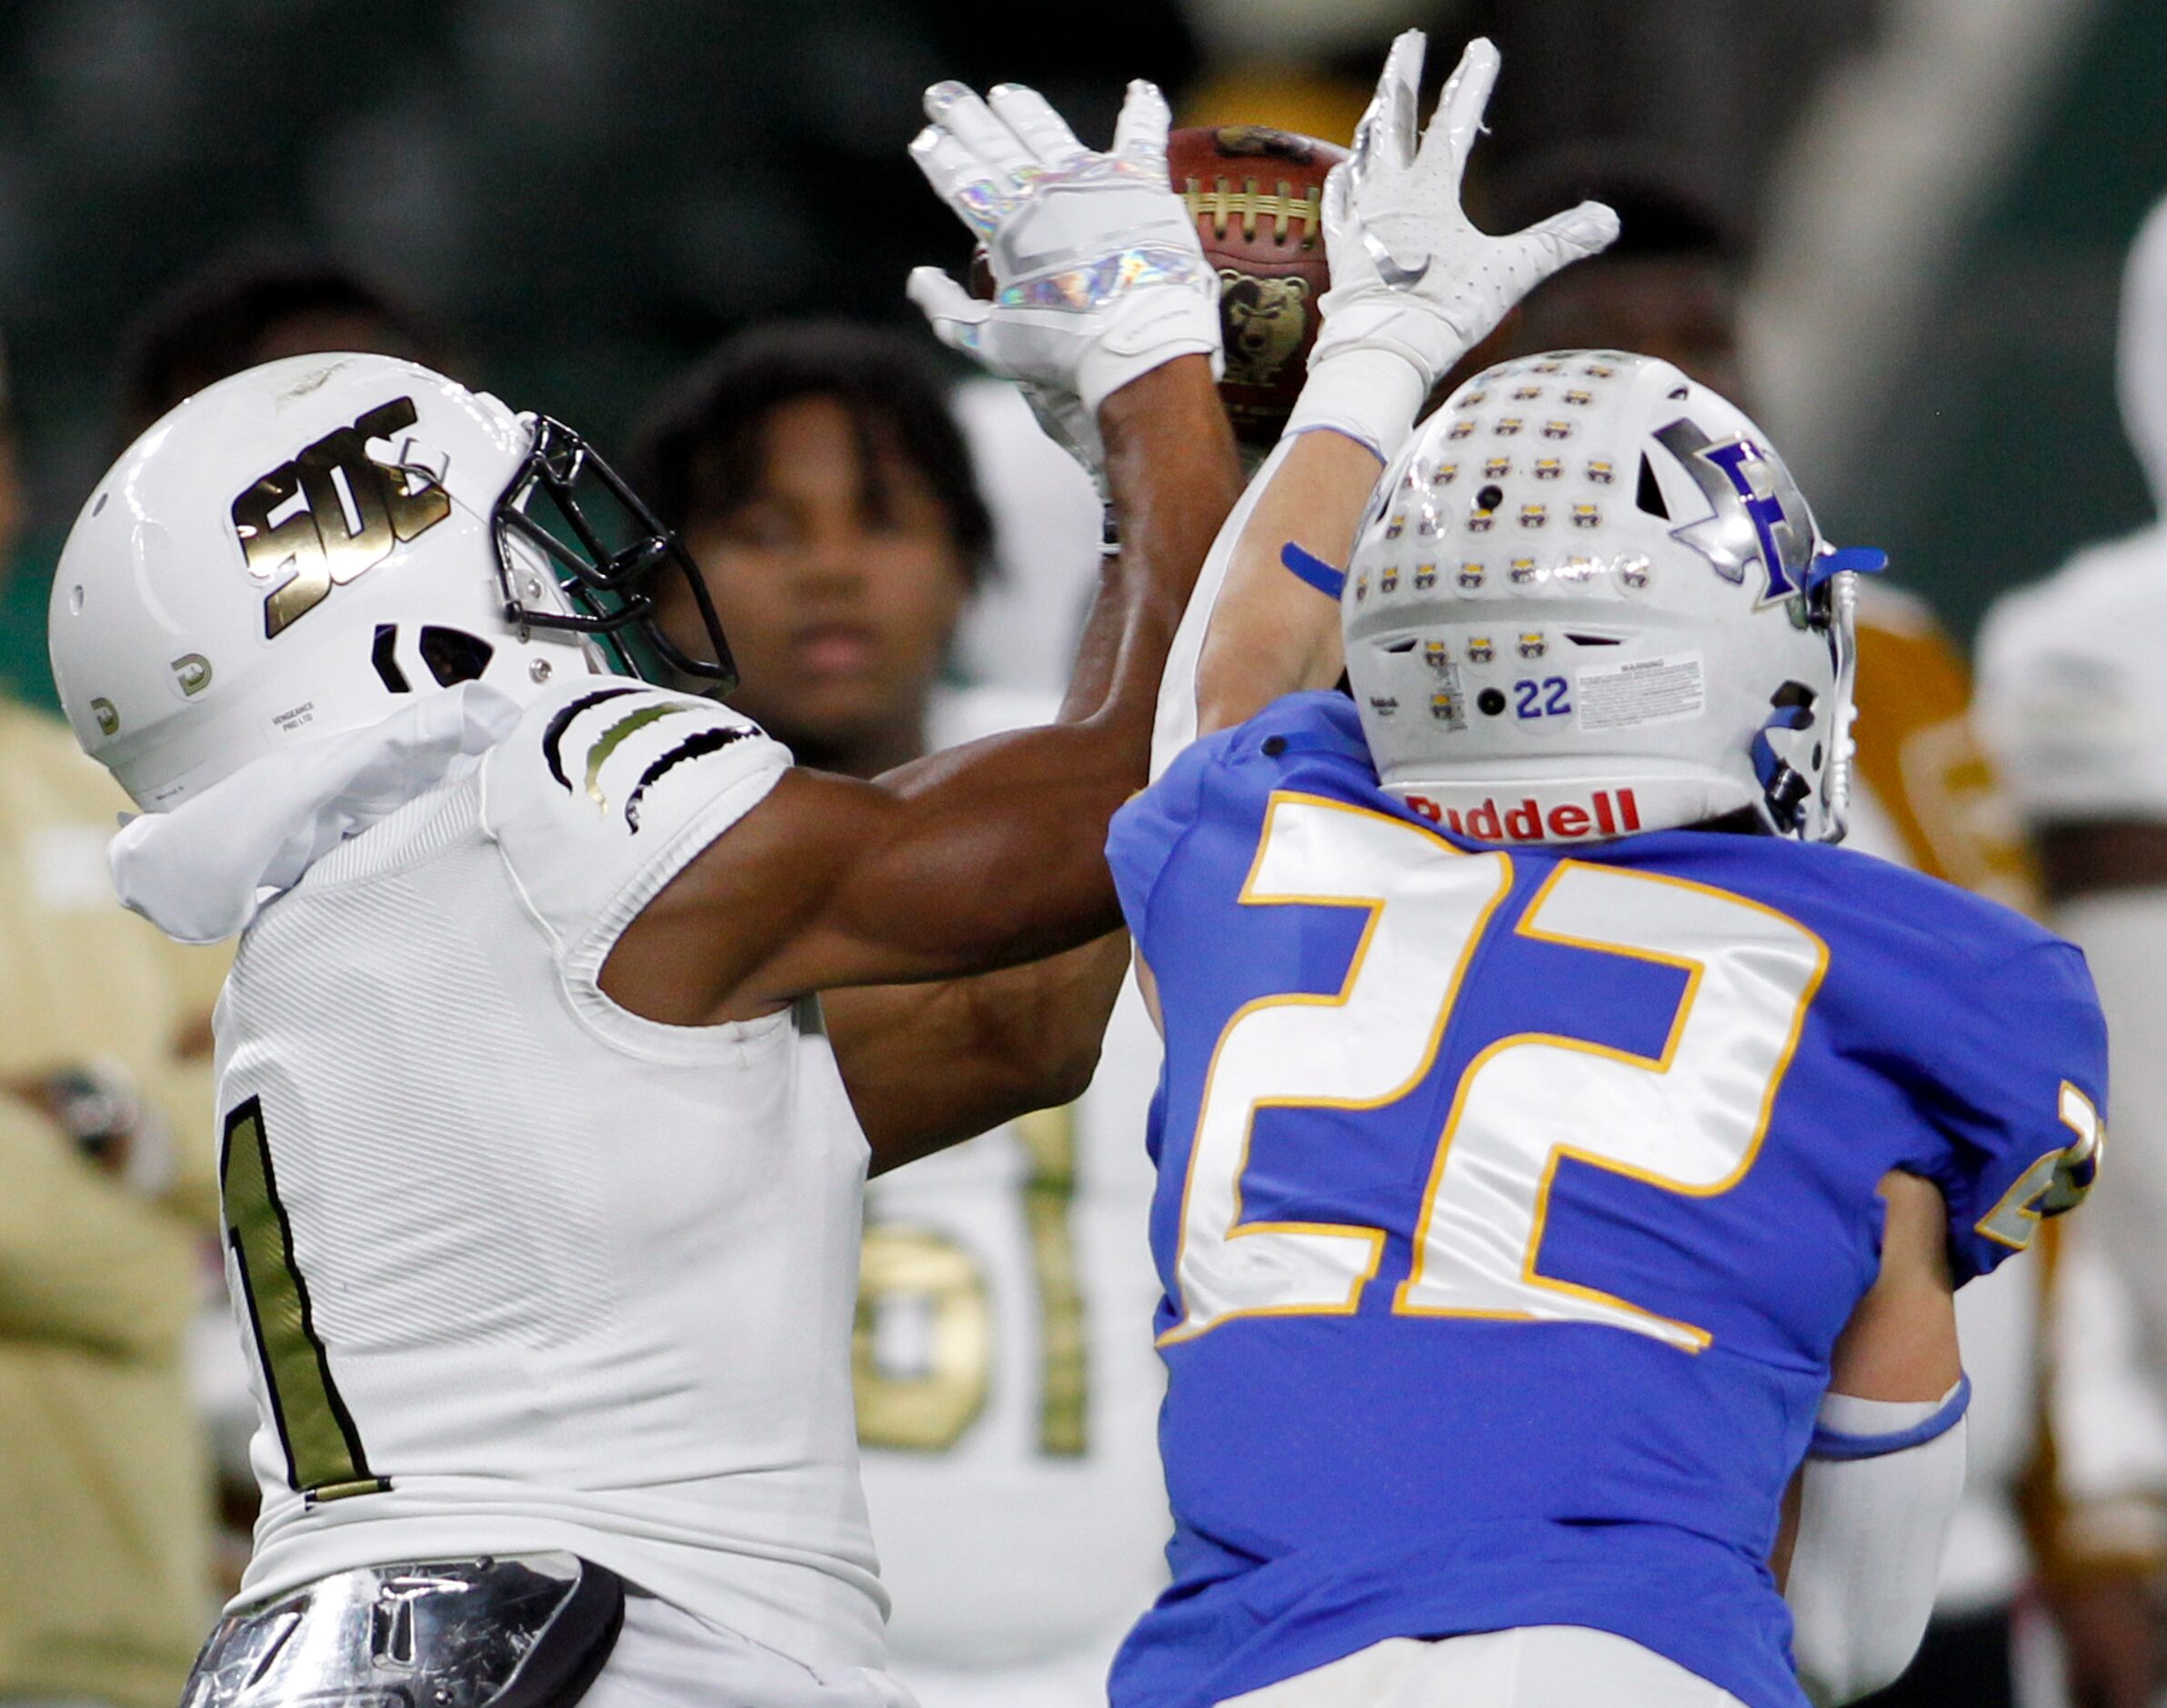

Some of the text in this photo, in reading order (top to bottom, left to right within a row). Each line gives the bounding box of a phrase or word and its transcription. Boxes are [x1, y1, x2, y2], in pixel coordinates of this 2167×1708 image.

[1513, 676, 1572, 719] 22
[1154, 790, 1831, 1354] 22
[220, 1094, 393, 1510] 1
